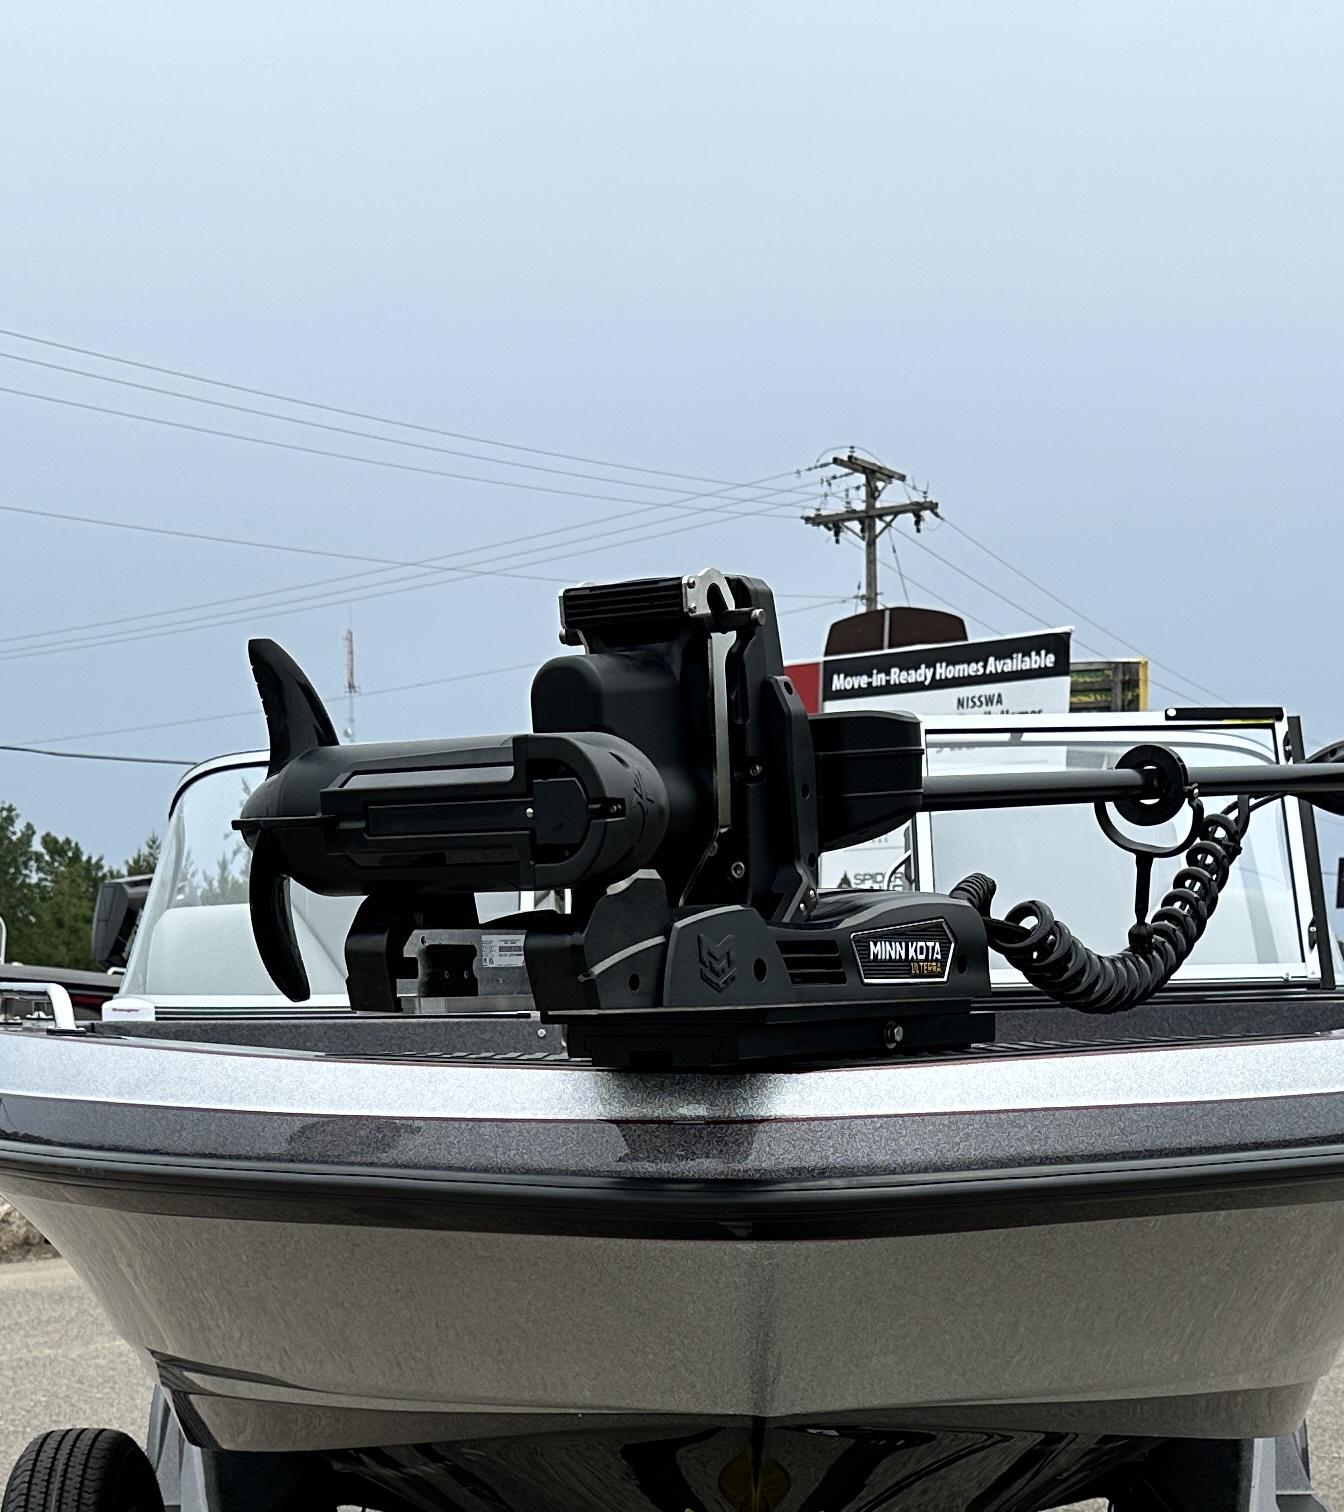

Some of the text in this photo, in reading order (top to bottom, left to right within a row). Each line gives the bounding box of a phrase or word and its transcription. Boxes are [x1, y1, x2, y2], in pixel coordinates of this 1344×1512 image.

[831, 649, 1055, 692] Move-in-Ready Homes Available
[956, 692, 1004, 711] NISSWA
[869, 941, 942, 960] MINN KOTA
